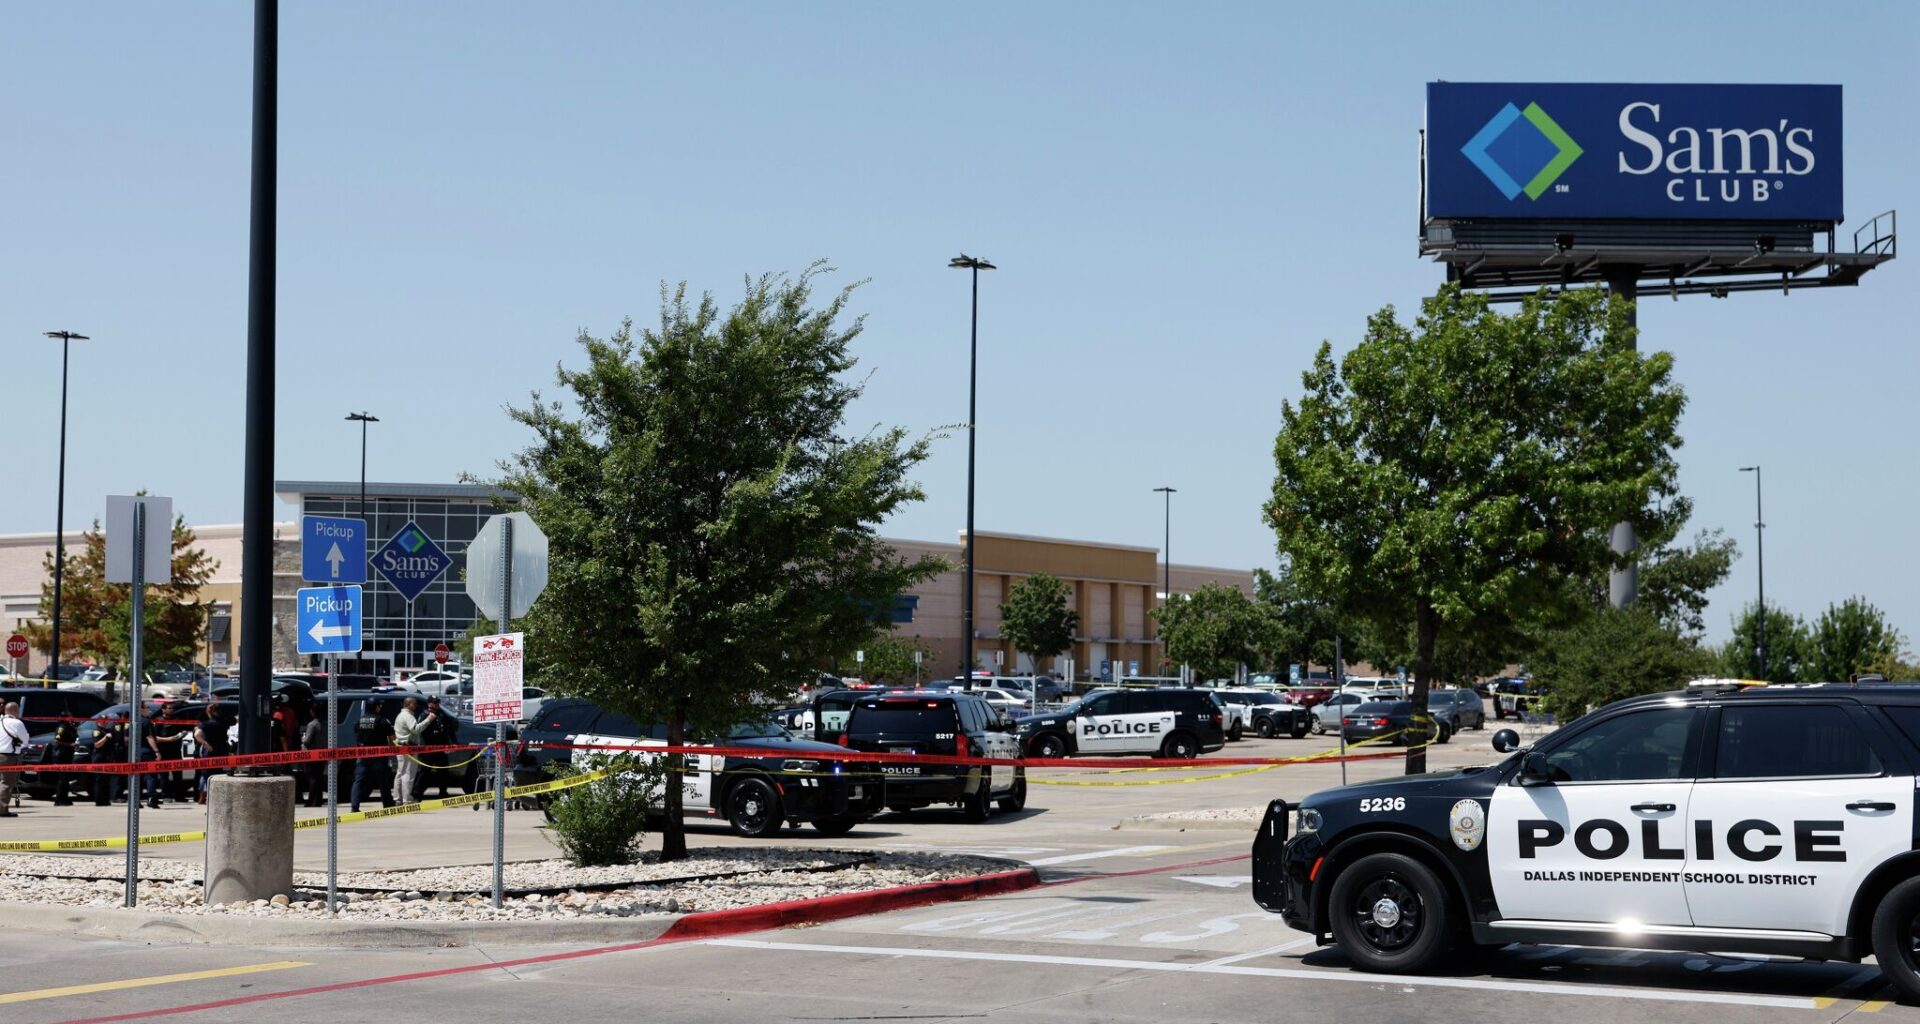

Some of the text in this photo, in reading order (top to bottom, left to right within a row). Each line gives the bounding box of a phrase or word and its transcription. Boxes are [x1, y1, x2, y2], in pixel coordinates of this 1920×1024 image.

[1619, 102, 1815, 175] Sam's
[316, 522, 354, 541] Pickup
[383, 550, 439, 571] Sam's
[306, 597, 352, 616] Pickup
[453, 631, 467, 639] Exit
[8, 642, 27, 651] STOP
[1083, 722, 1161, 735] POLICE
[293, 752, 311, 761] CROSS
[442, 798, 456, 806] POLICE
[471, 794, 480, 802] NOT
[1359, 797, 1406, 812] 5236
[364, 804, 421, 819] POLICE LINE DO NOT CROSS
[299, 820, 309, 828] LINE
[58, 841, 71, 849] POLICE
[80, 840, 85, 848] DO
[94, 839, 107, 847] CROSS
[158, 835, 166, 843] NOT
[166, 834, 181, 842] CROSS
[1517, 818, 1847, 863] POLICE
[1523, 871, 1818, 886] DALLAS INDEPENDENT SCHOOL DISTRICT
